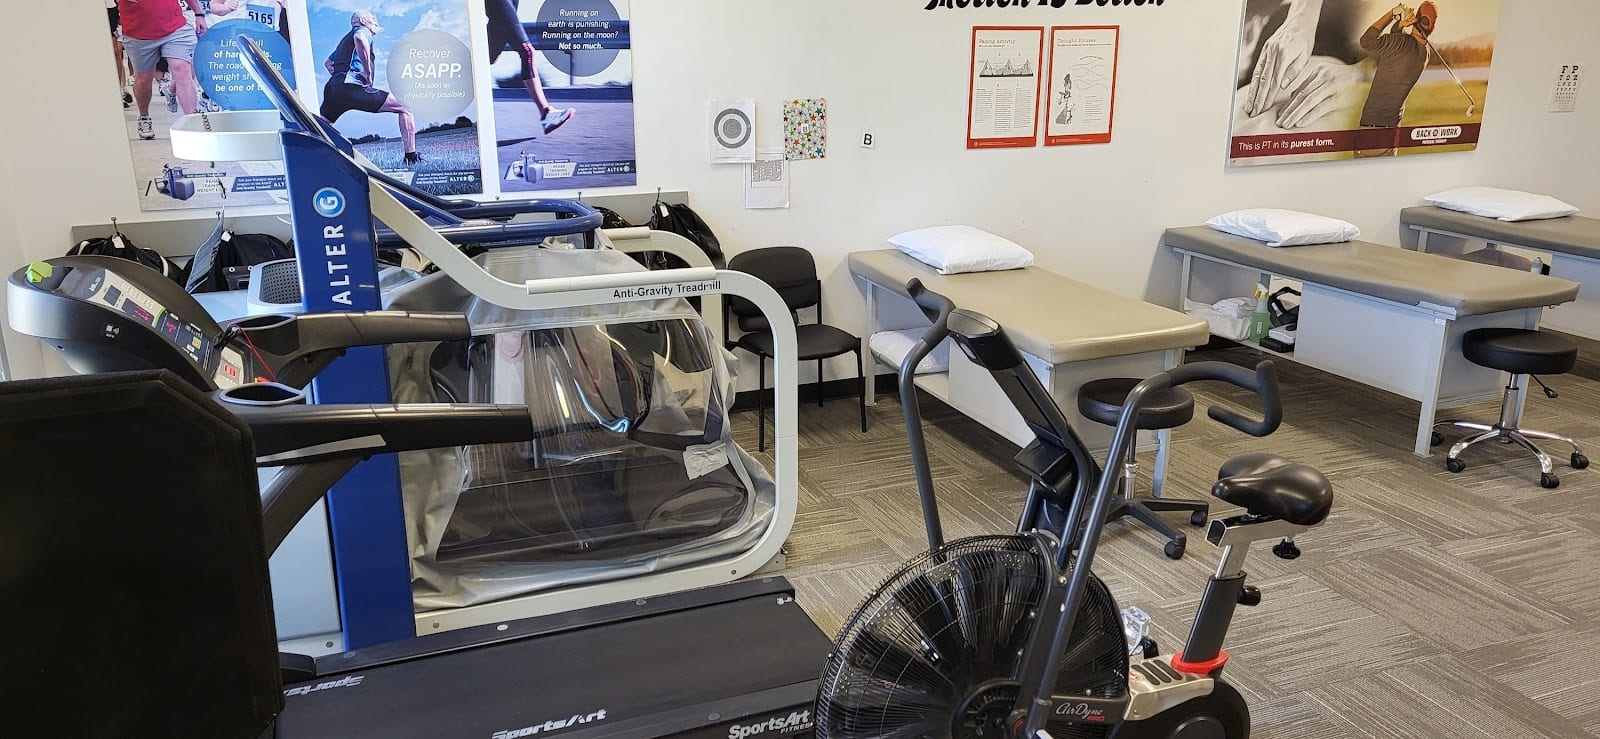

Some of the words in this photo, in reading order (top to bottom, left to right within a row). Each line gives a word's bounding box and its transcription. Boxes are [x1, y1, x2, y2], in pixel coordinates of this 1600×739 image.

[248, 11, 273, 25] 5165
[559, 9, 588, 17] Running
[547, 20, 566, 28] earth
[575, 20, 611, 30] punishing.
[542, 31, 571, 40] Running
[583, 31, 595, 39] the
[596, 31, 618, 39] moon?
[220, 39, 238, 48] Life
[558, 42, 571, 50] Not
[582, 42, 603, 50] much.
[214, 50, 223, 59] of
[408, 48, 451, 59] Recover
[208, 61, 224, 70] The
[1562, 65, 1569, 73] F
[1572, 65, 1579, 73] P
[401, 63, 462, 79] ASAPP.
[212, 73, 240, 83] weight
[215, 84, 225, 92] be
[246, 84, 256, 92] of
[414, 81, 425, 90] (As
[427, 82, 442, 90] soon
[403, 91, 435, 100] physically
[437, 90, 466, 100] possible)
[1415, 129, 1432, 138] BACK
[1440, 127, 1459, 136] WORK
[863, 133, 873, 146] B
[1238, 142, 1253, 151] This
[1254, 142, 1260, 151] is
[1261, 140, 1272, 150] PT
[1272, 141, 1280, 149] in
[1280, 140, 1289, 149] its
[1290, 139, 1314, 150] purest
[1315, 138, 1335, 148] form.
[323, 224, 353, 305] ALTER
[613, 285, 673, 299] Anti-Gravity
[676, 280, 721, 293] Treadmill
[283, 675, 365, 697] Sports
[1056, 702, 1104, 720] AirDyne
[492, 708, 607, 739] SportsArt
[728, 709, 811, 739] SportsArt
